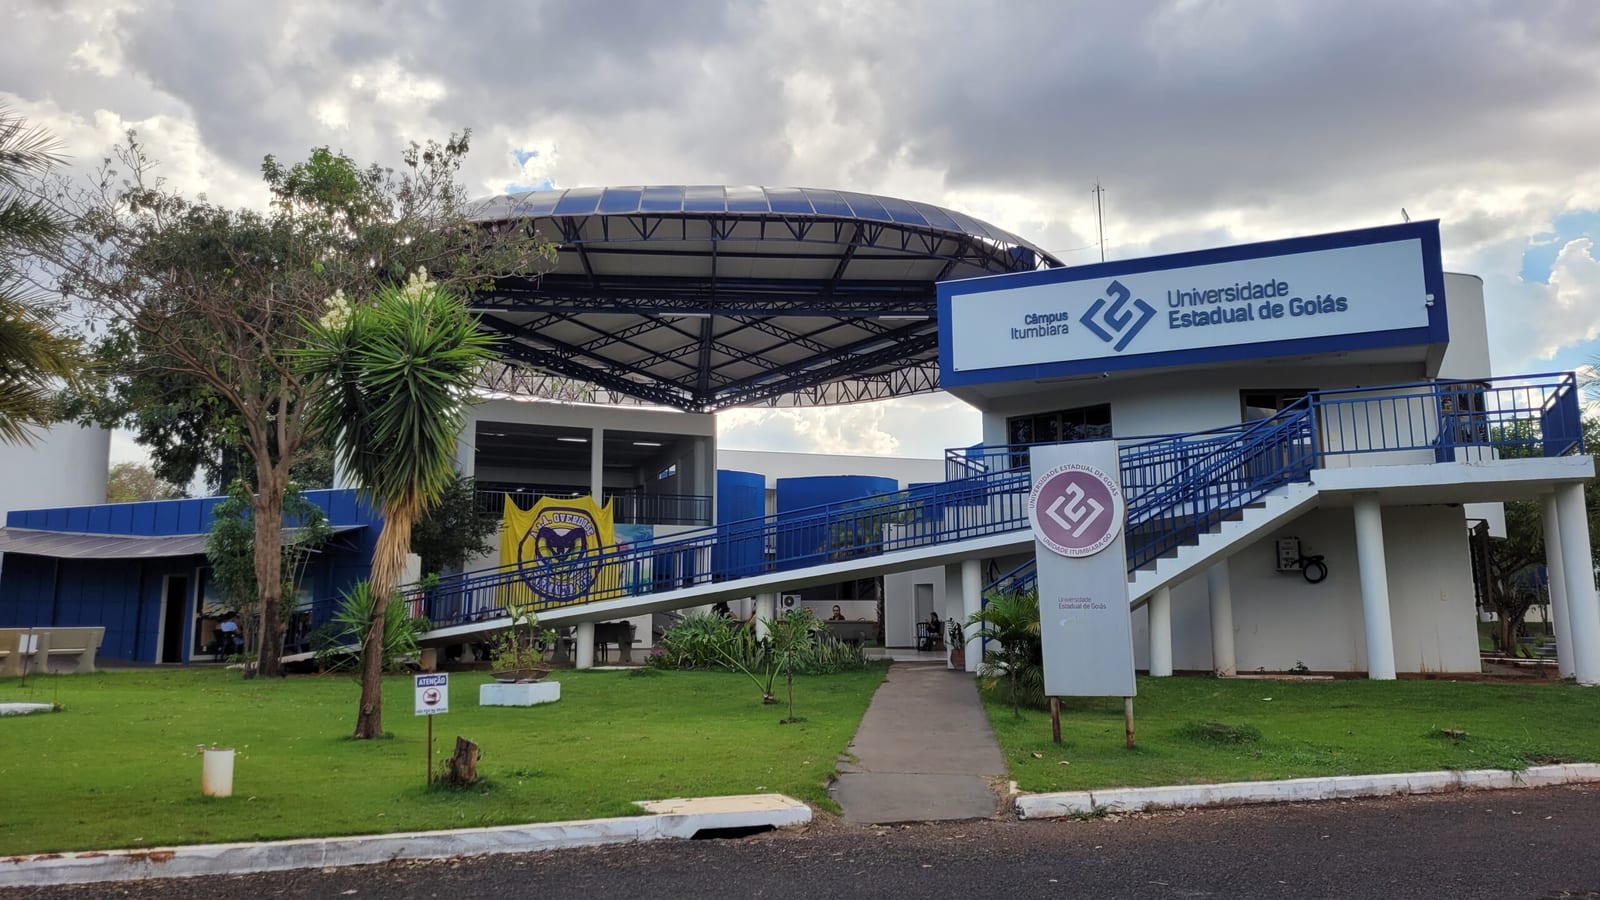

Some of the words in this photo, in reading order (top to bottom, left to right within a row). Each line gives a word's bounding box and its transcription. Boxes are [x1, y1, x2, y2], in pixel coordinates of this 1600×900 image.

[1167, 278, 1289, 308] Universidade
[1024, 311, 1069, 326] Câmpus
[1169, 302, 1255, 330] Estadual
[1259, 300, 1285, 320] de
[1288, 293, 1348, 317] Goiás
[1011, 322, 1069, 340] Itumbiara
[1029, 469, 1059, 508] UNIVERSIDADE
[1060, 463, 1093, 472] ESTADUAL
[1103, 475, 1119, 497] GOIÁS
[1043, 537, 1069, 554] UNIDADE
[418, 675, 446, 686] ATENÇÃO
